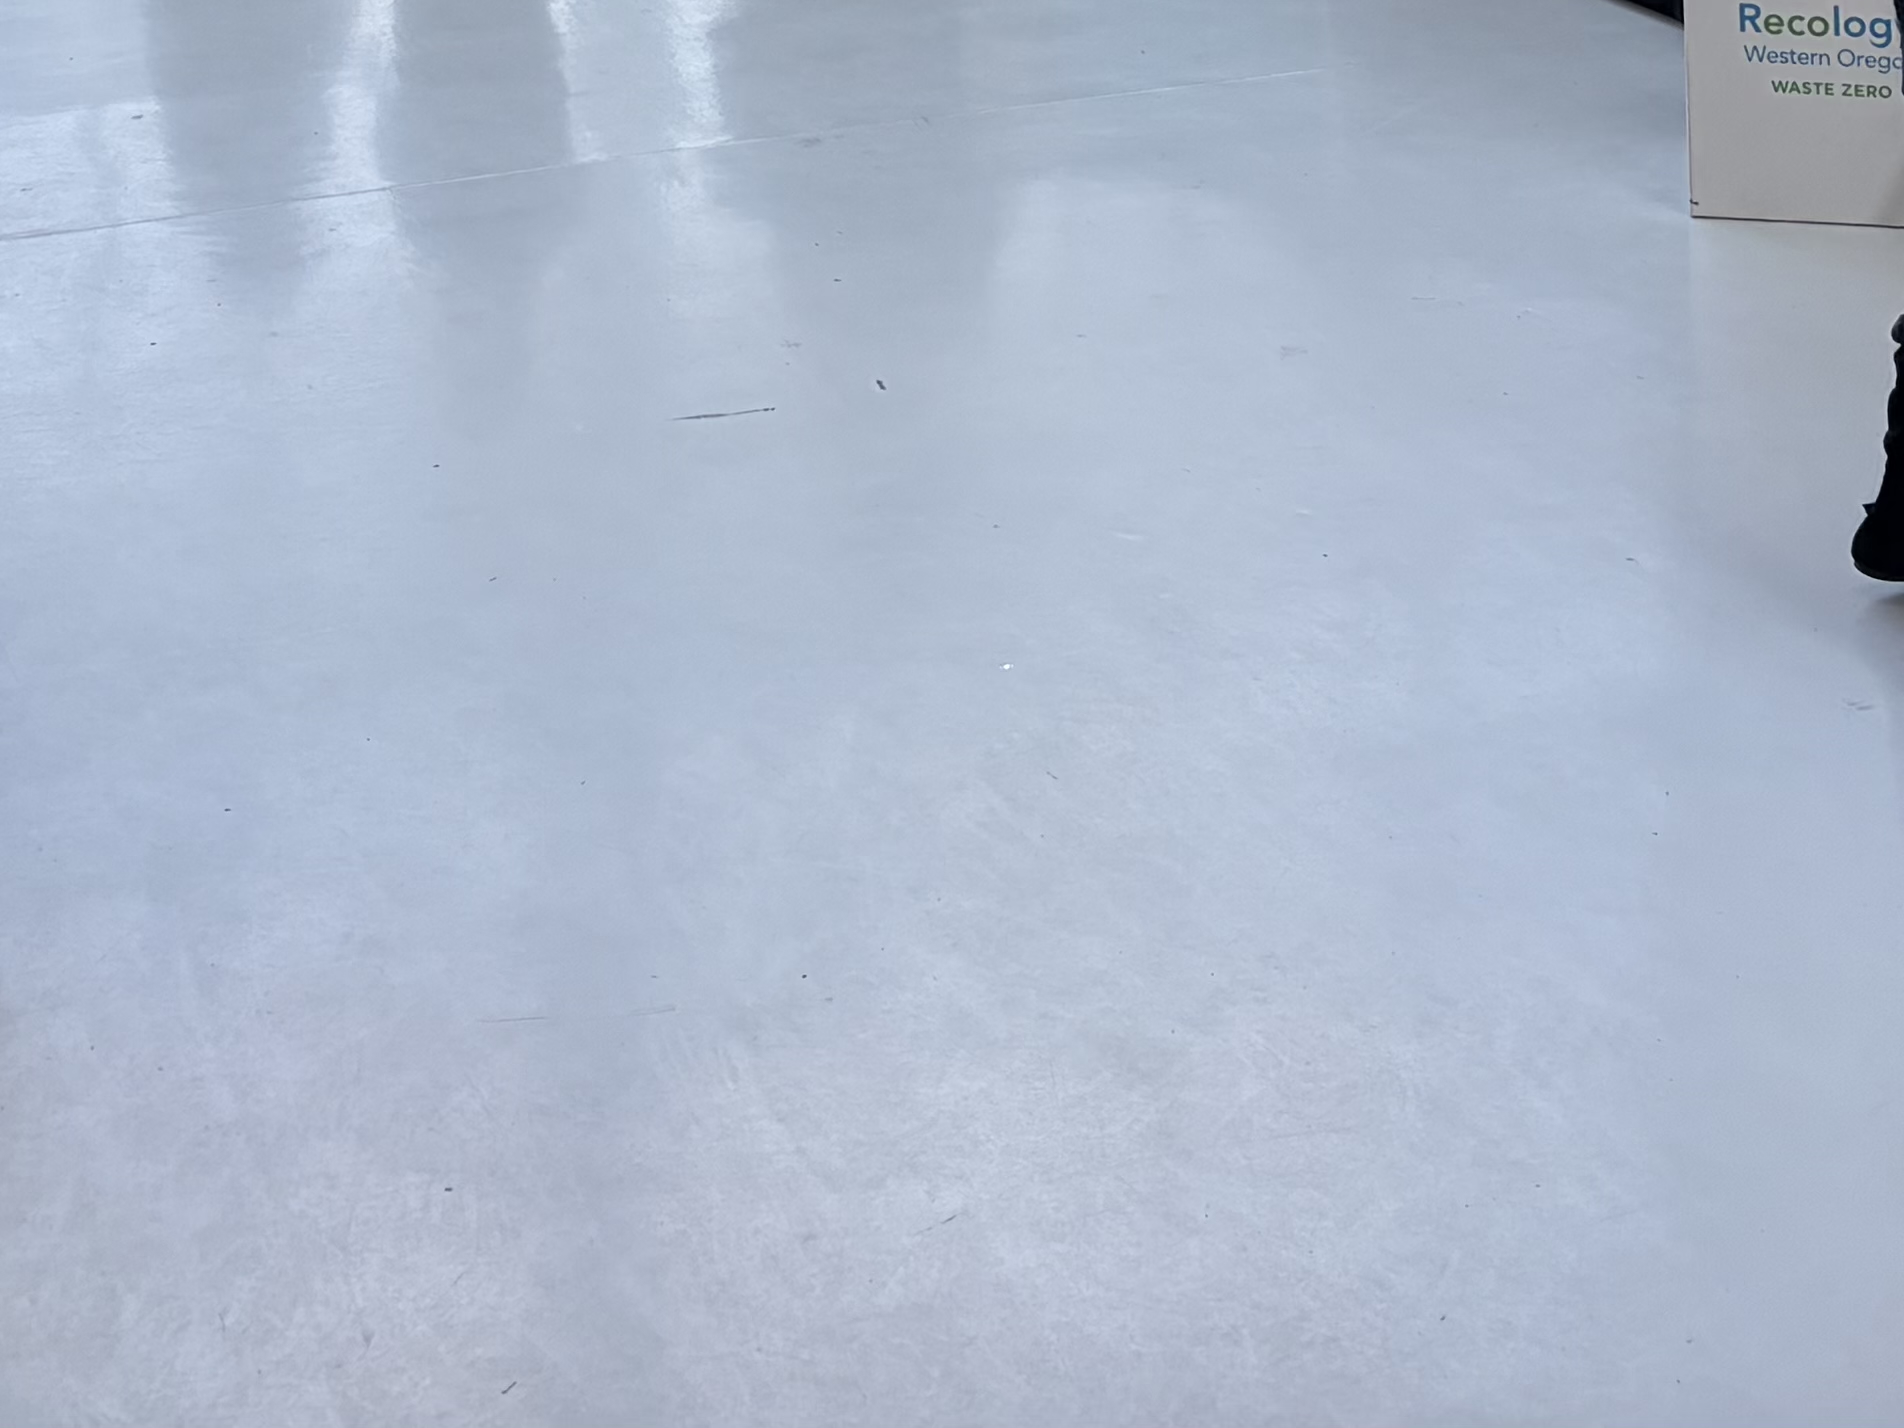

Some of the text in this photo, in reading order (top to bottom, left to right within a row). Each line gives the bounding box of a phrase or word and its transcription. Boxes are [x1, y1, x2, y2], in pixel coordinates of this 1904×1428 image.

[1738, 2, 1900, 49] Recolog
[1743, 45, 1903, 75] Western Orego
[1771, 80, 1893, 100] WASTE ZERO
